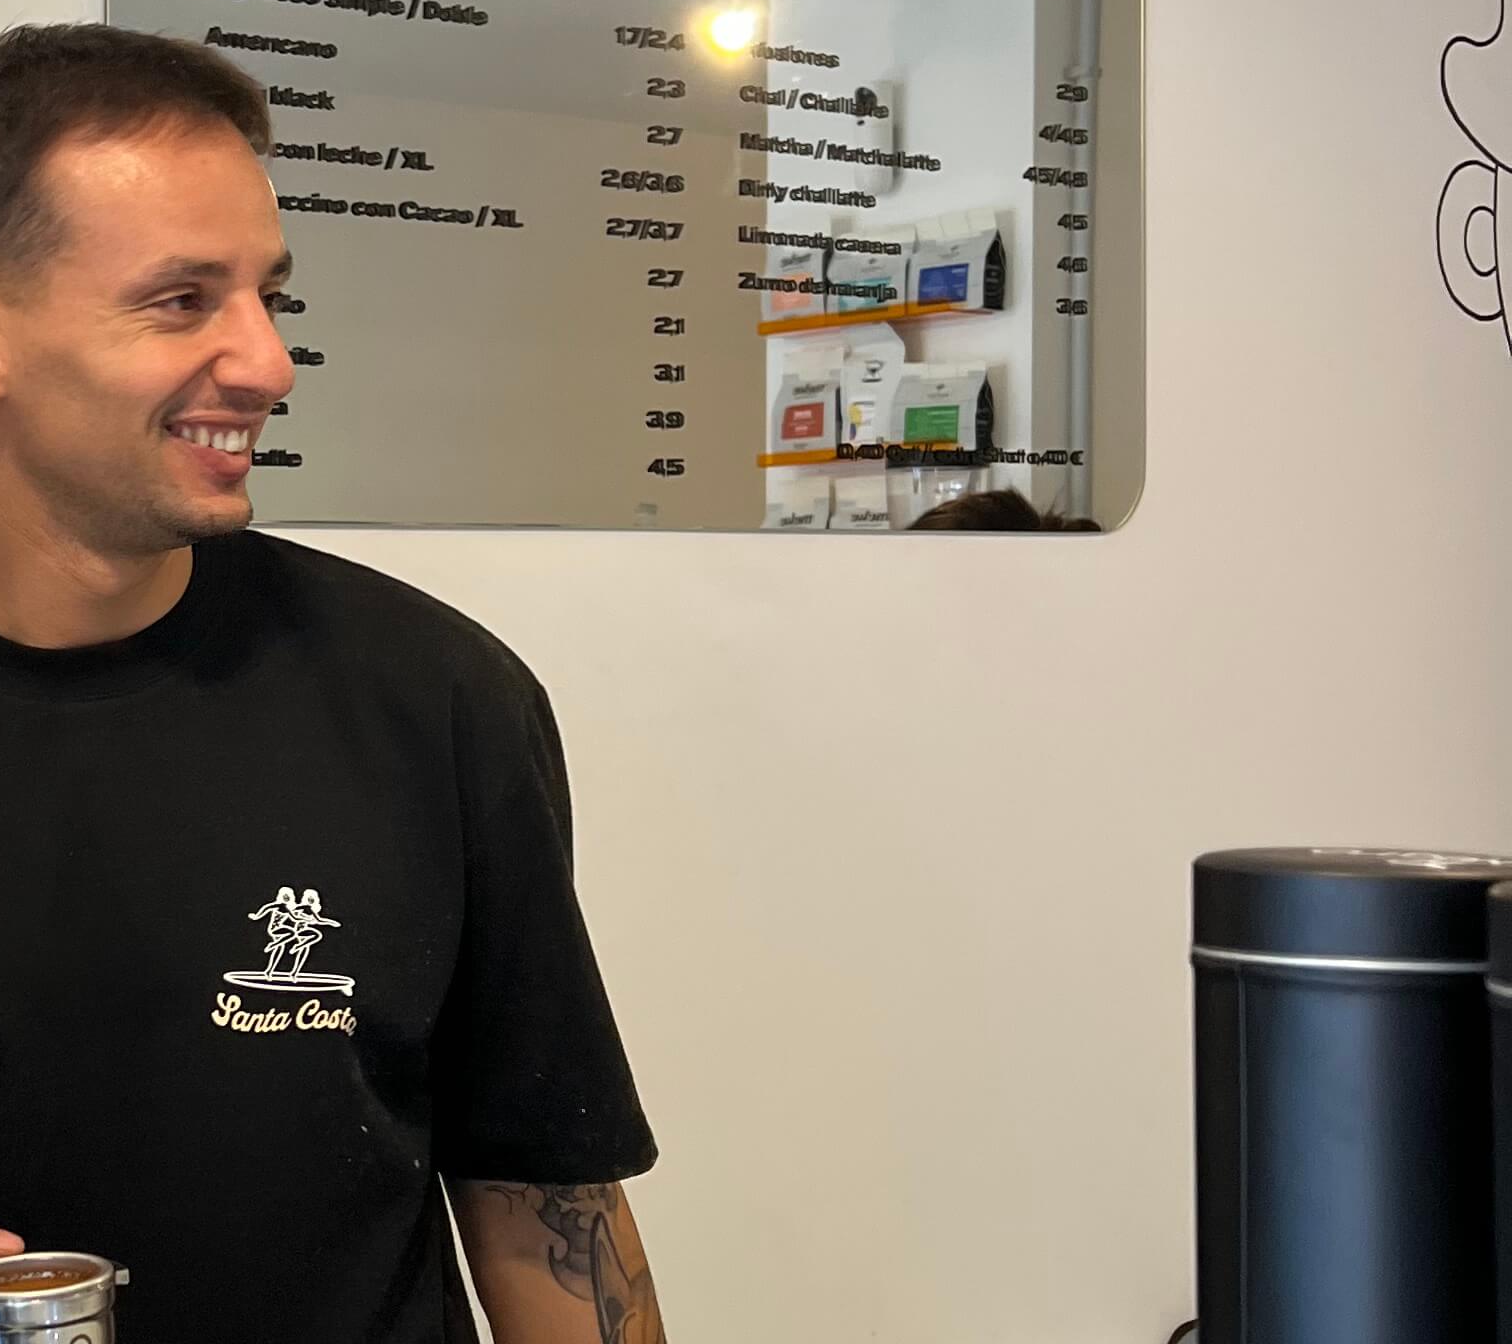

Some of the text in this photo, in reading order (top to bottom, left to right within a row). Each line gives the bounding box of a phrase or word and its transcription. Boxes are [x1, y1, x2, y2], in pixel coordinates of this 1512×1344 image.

[422, 0, 489, 26] Doble
[204, 26, 338, 59] Americano
[269, 86, 335, 110] black
[317, 143, 383, 167] leche
[400, 150, 435, 171] XL
[398, 201, 474, 224] Cacao
[491, 208, 524, 228] XL
[738, 272, 797, 293] Zumo
[211, 992, 292, 1033] Santa
